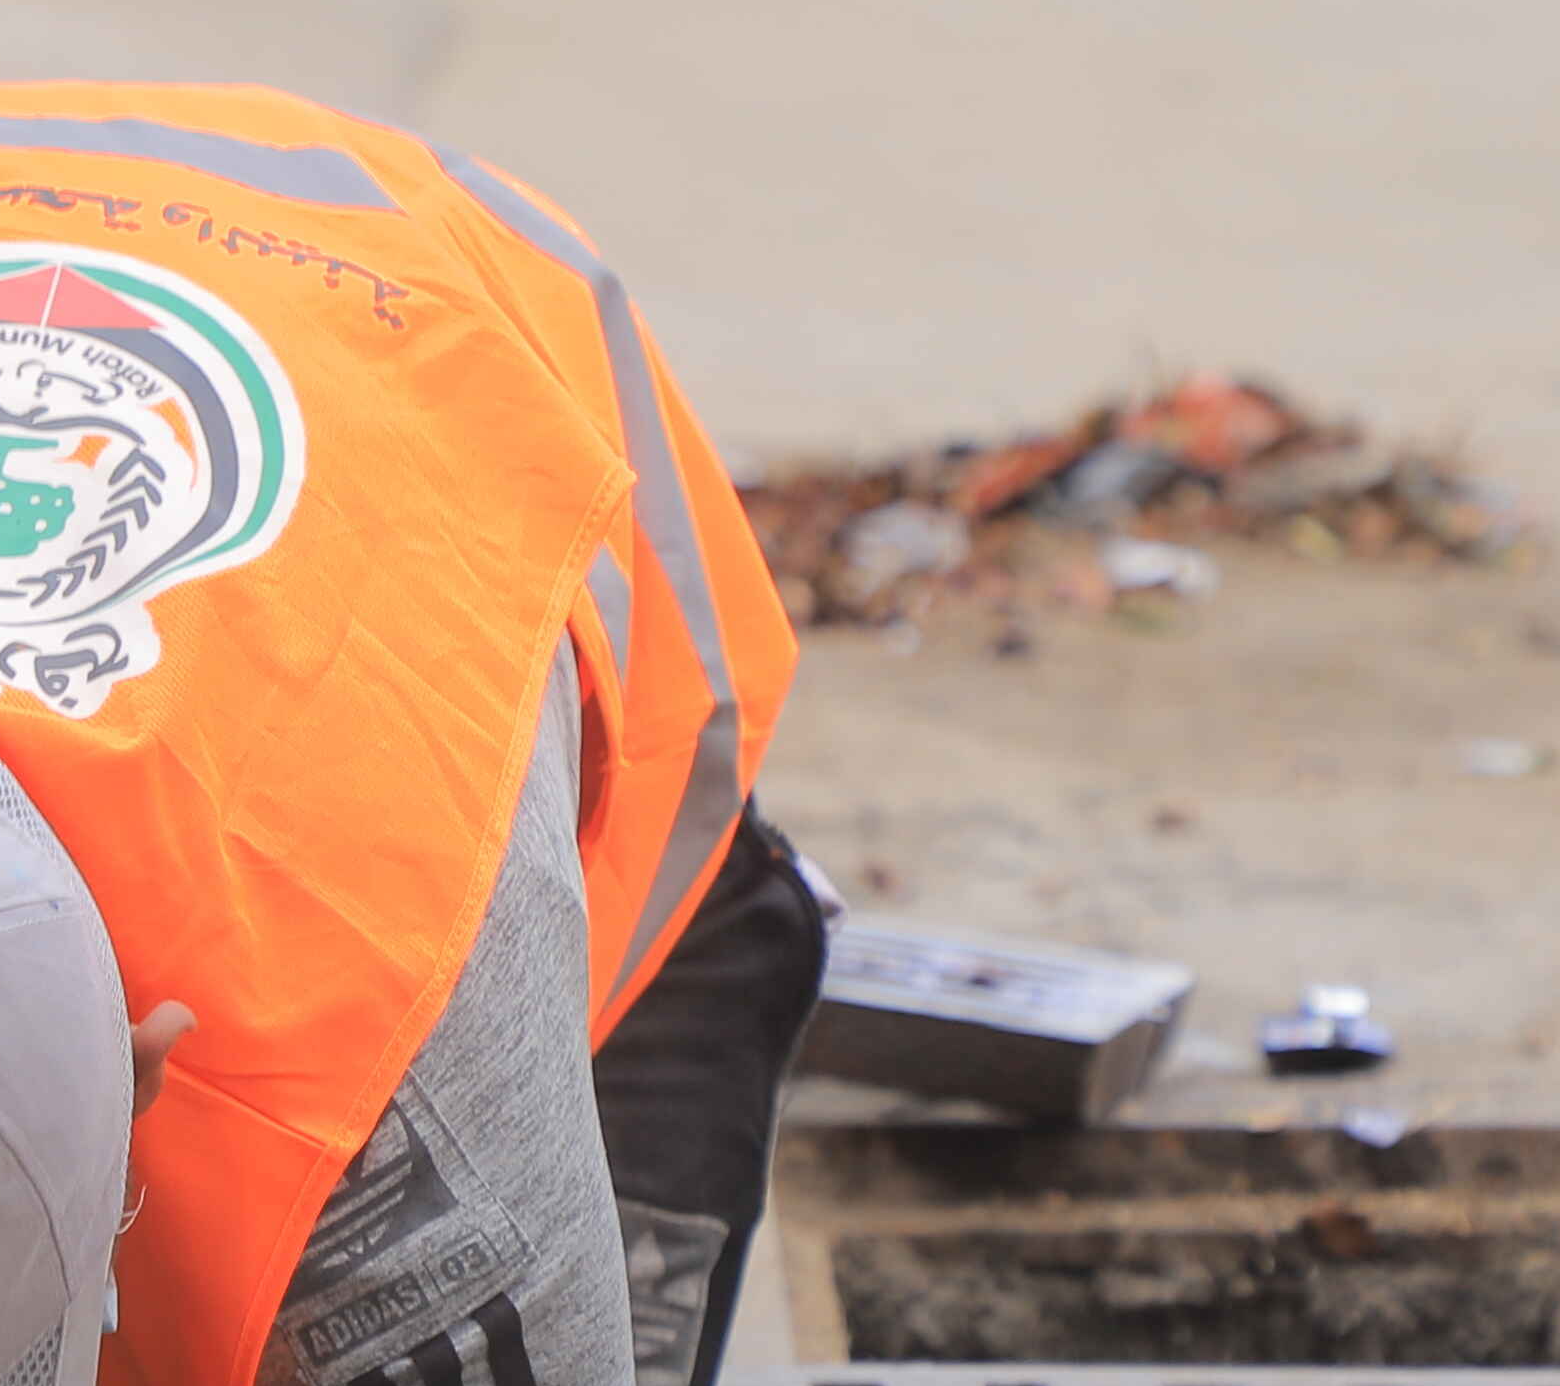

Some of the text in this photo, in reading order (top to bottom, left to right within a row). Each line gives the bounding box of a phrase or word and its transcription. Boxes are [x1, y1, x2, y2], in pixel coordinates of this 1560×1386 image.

[15, 361, 124, 407] رفح
[81, 346, 163, 401] Rafah
[306, 1280, 424, 1360] ADIDAS
